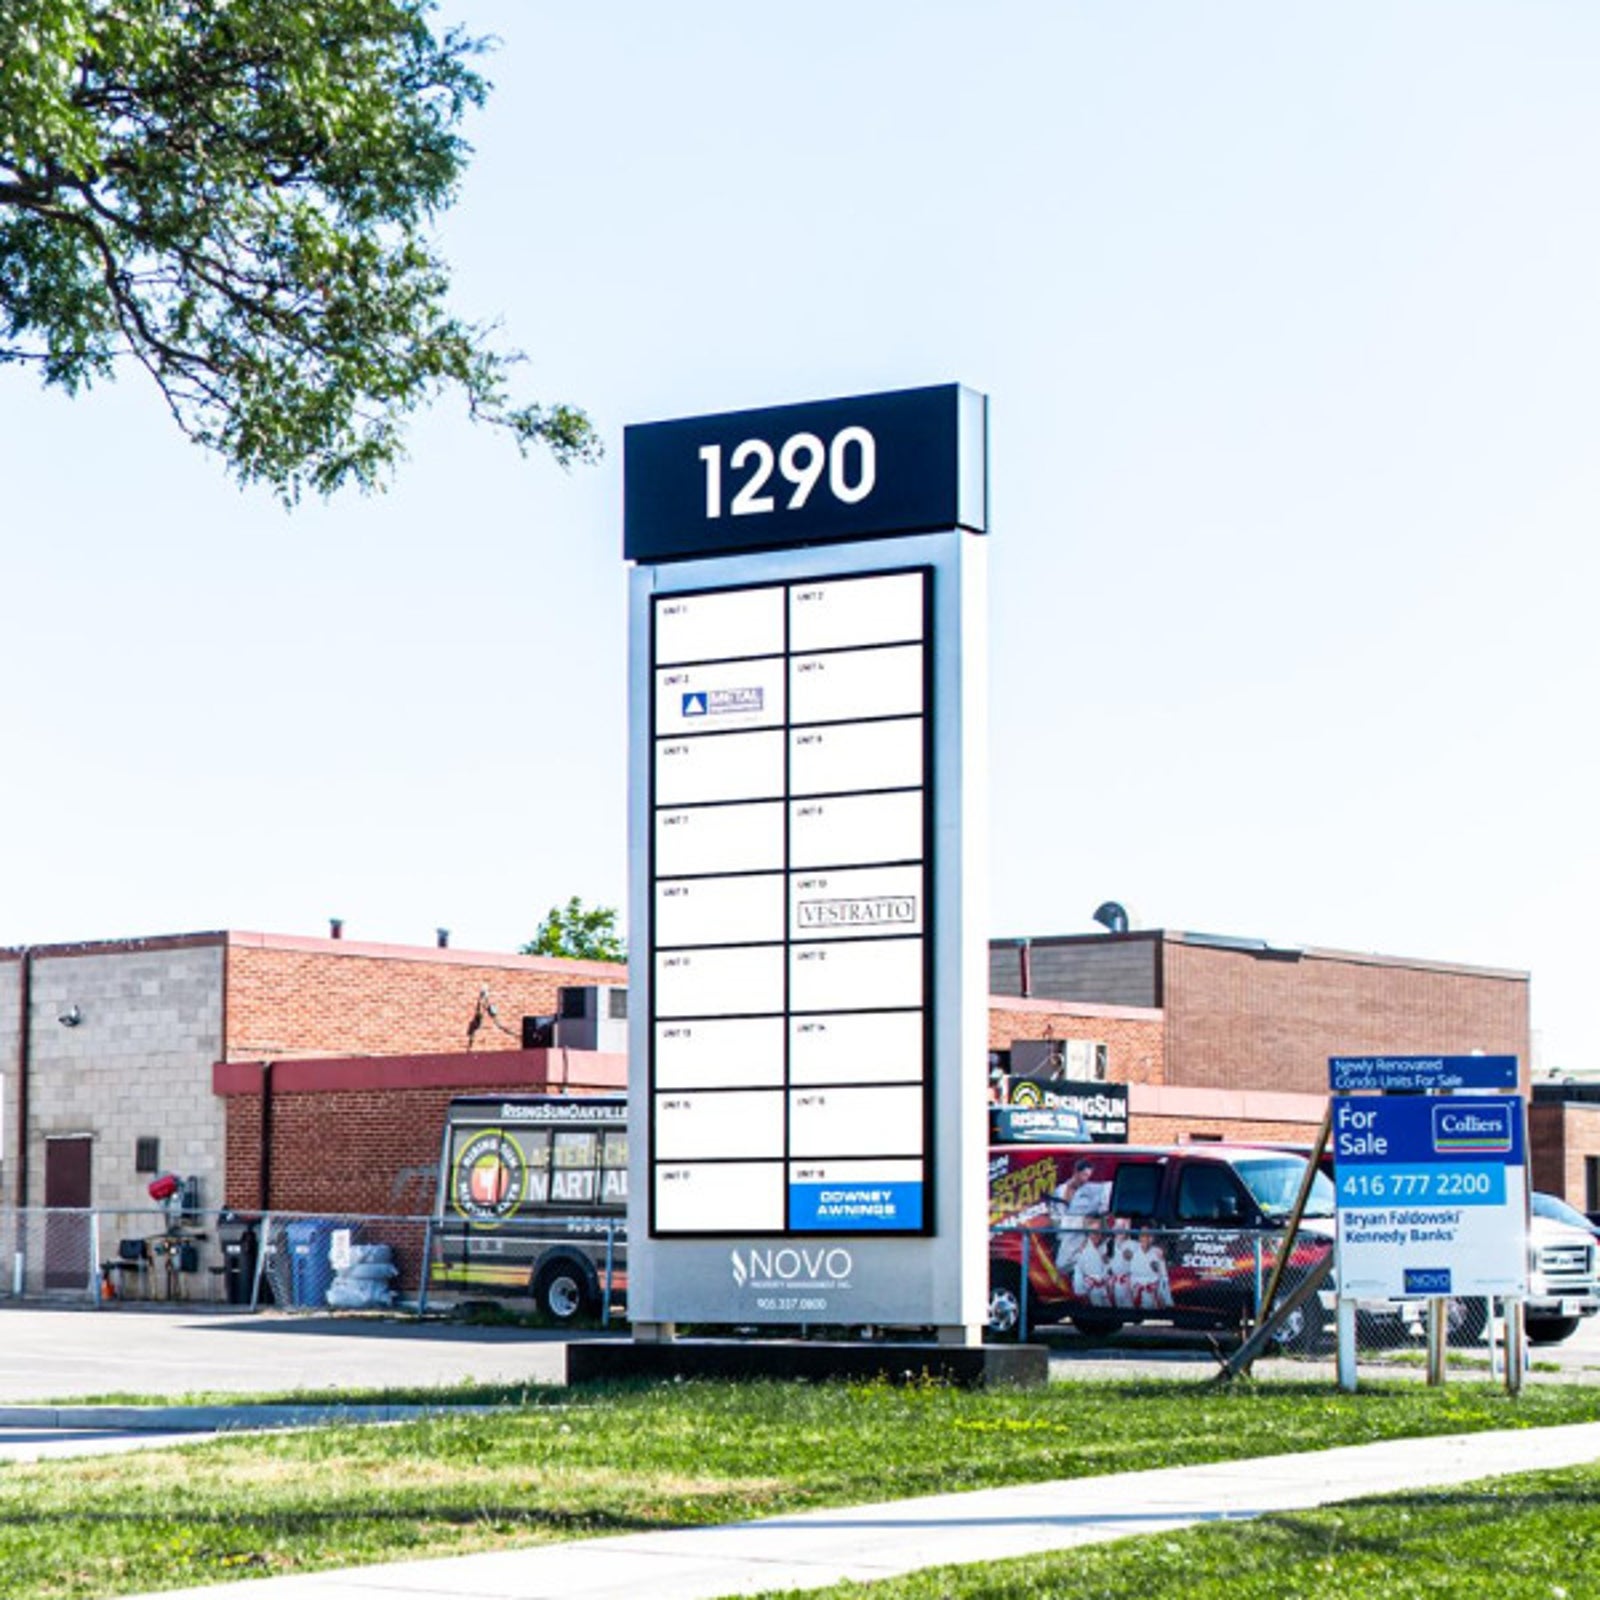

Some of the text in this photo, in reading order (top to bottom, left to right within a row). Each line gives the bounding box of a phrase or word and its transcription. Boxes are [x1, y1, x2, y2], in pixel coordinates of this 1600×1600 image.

[699, 425, 876, 519] 1290
[797, 592, 816, 601] UNIT
[663, 604, 681, 615] UNIT
[798, 663, 816, 672] UNIT
[664, 675, 681, 686] UNIT
[797, 735, 815, 745] UNIT
[664, 746, 681, 755] UNIT
[797, 807, 816, 816] UNIT
[664, 816, 681, 825] UNIT
[797, 880, 816, 889] UNIT
[663, 888, 681, 897] UNIT
[803, 901, 911, 922] VESTRATTO
[797, 951, 816, 960] UNIT
[664, 958, 681, 967] UNIT
[664, 1029, 681, 1038] UNIT
[797, 1024, 816, 1033] UNIT
[1335, 1059, 1443, 1075] Newly Renovated
[1335, 1075, 1376, 1089] Condo
[1416, 1074, 1435, 1087] For
[1438, 1074, 1463, 1087] Sale
[664, 1101, 681, 1110] UNIT
[797, 1097, 815, 1105] UNIT
[1338, 1107, 1377, 1130] For
[1441, 1114, 1503, 1133] Colliers
[1340, 1132, 1388, 1156] Sale
[663, 1172, 681, 1180] UNIT
[797, 1170, 815, 1178] UNIT
[1343, 1173, 1490, 1196] 416 777 2200
[820, 1190, 892, 1203] DOWNEY
[817, 1204, 897, 1217] AWNINGS
[1344, 1212, 1388, 1229] Bryan
[1346, 1230, 1406, 1246] Kennedy
[750, 1248, 852, 1279] NOVO
